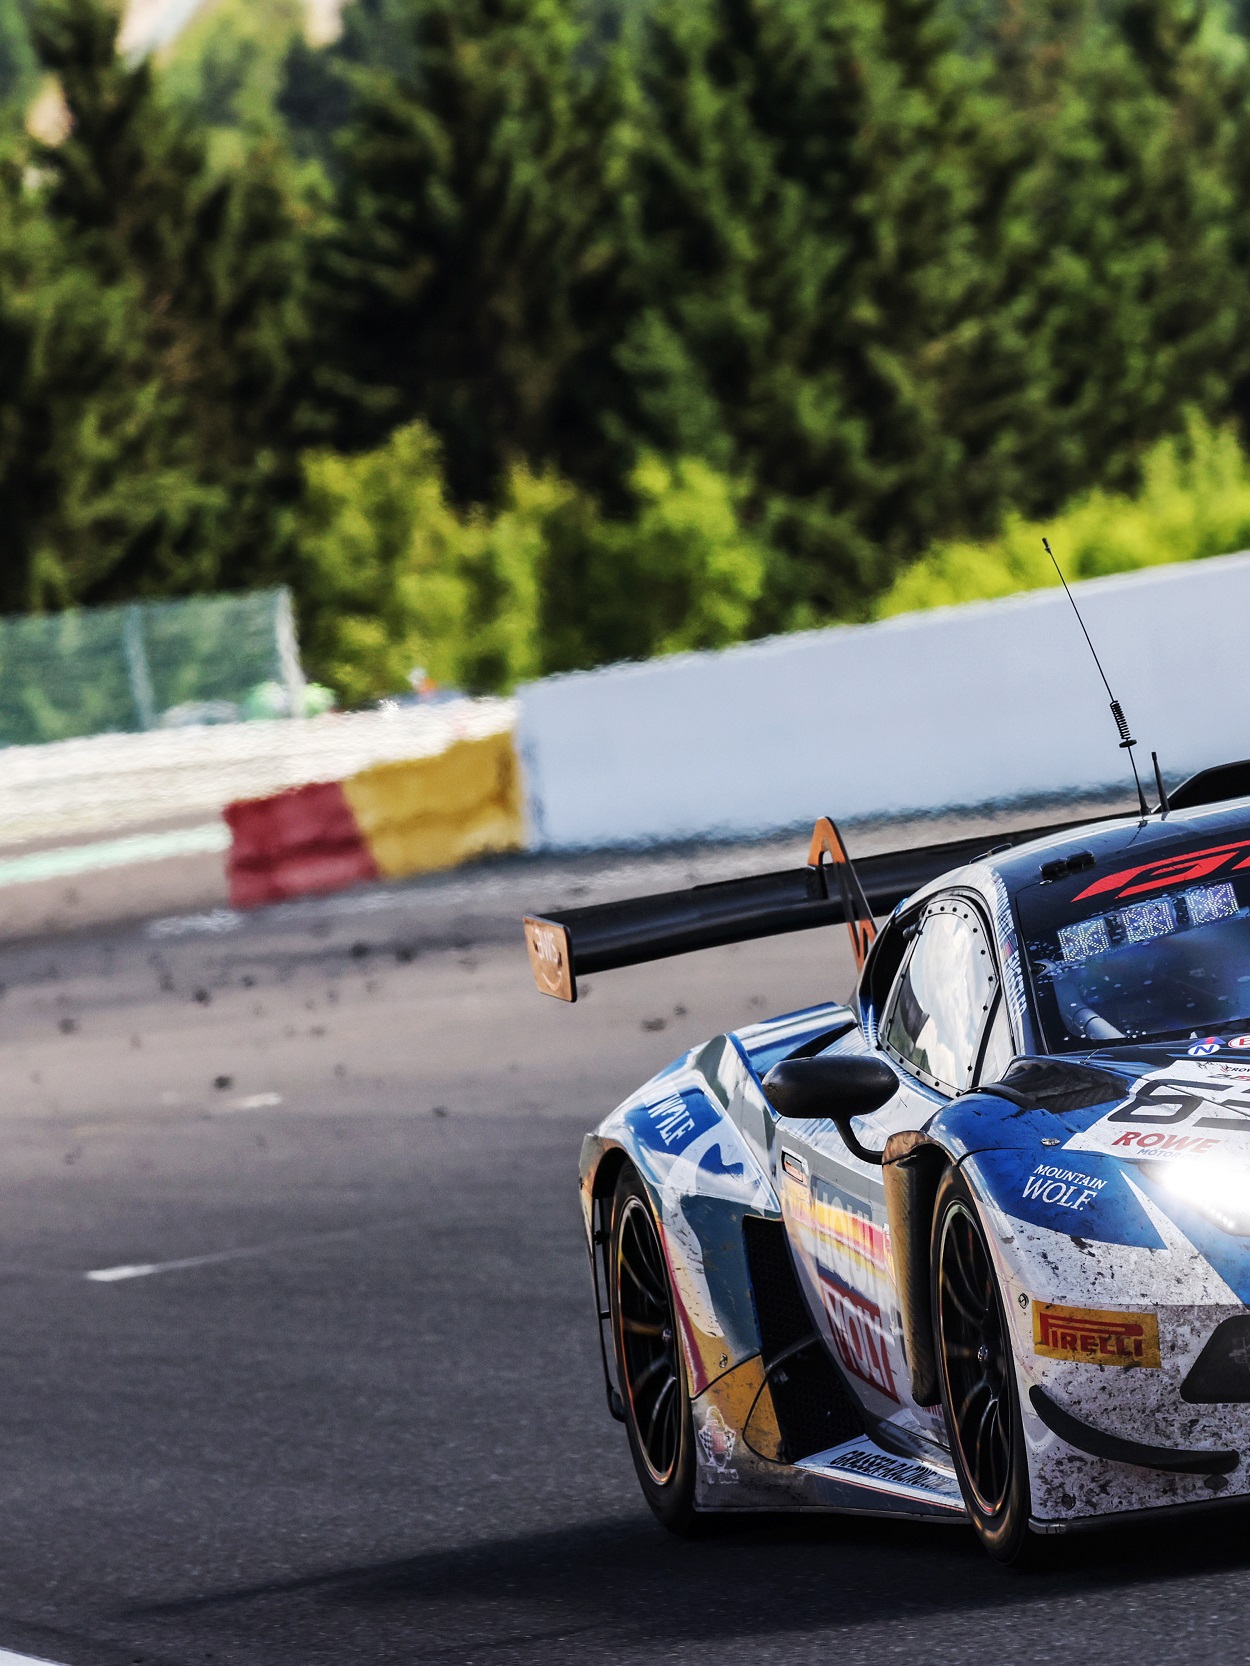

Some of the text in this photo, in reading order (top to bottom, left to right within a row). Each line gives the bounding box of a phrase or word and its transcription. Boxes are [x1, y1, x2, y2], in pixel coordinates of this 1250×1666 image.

[1111, 1131, 1221, 1153] ROWE
[1033, 1164, 1108, 1190] MOUNTAIN
[1040, 1312, 1144, 1357] PIRELLI
